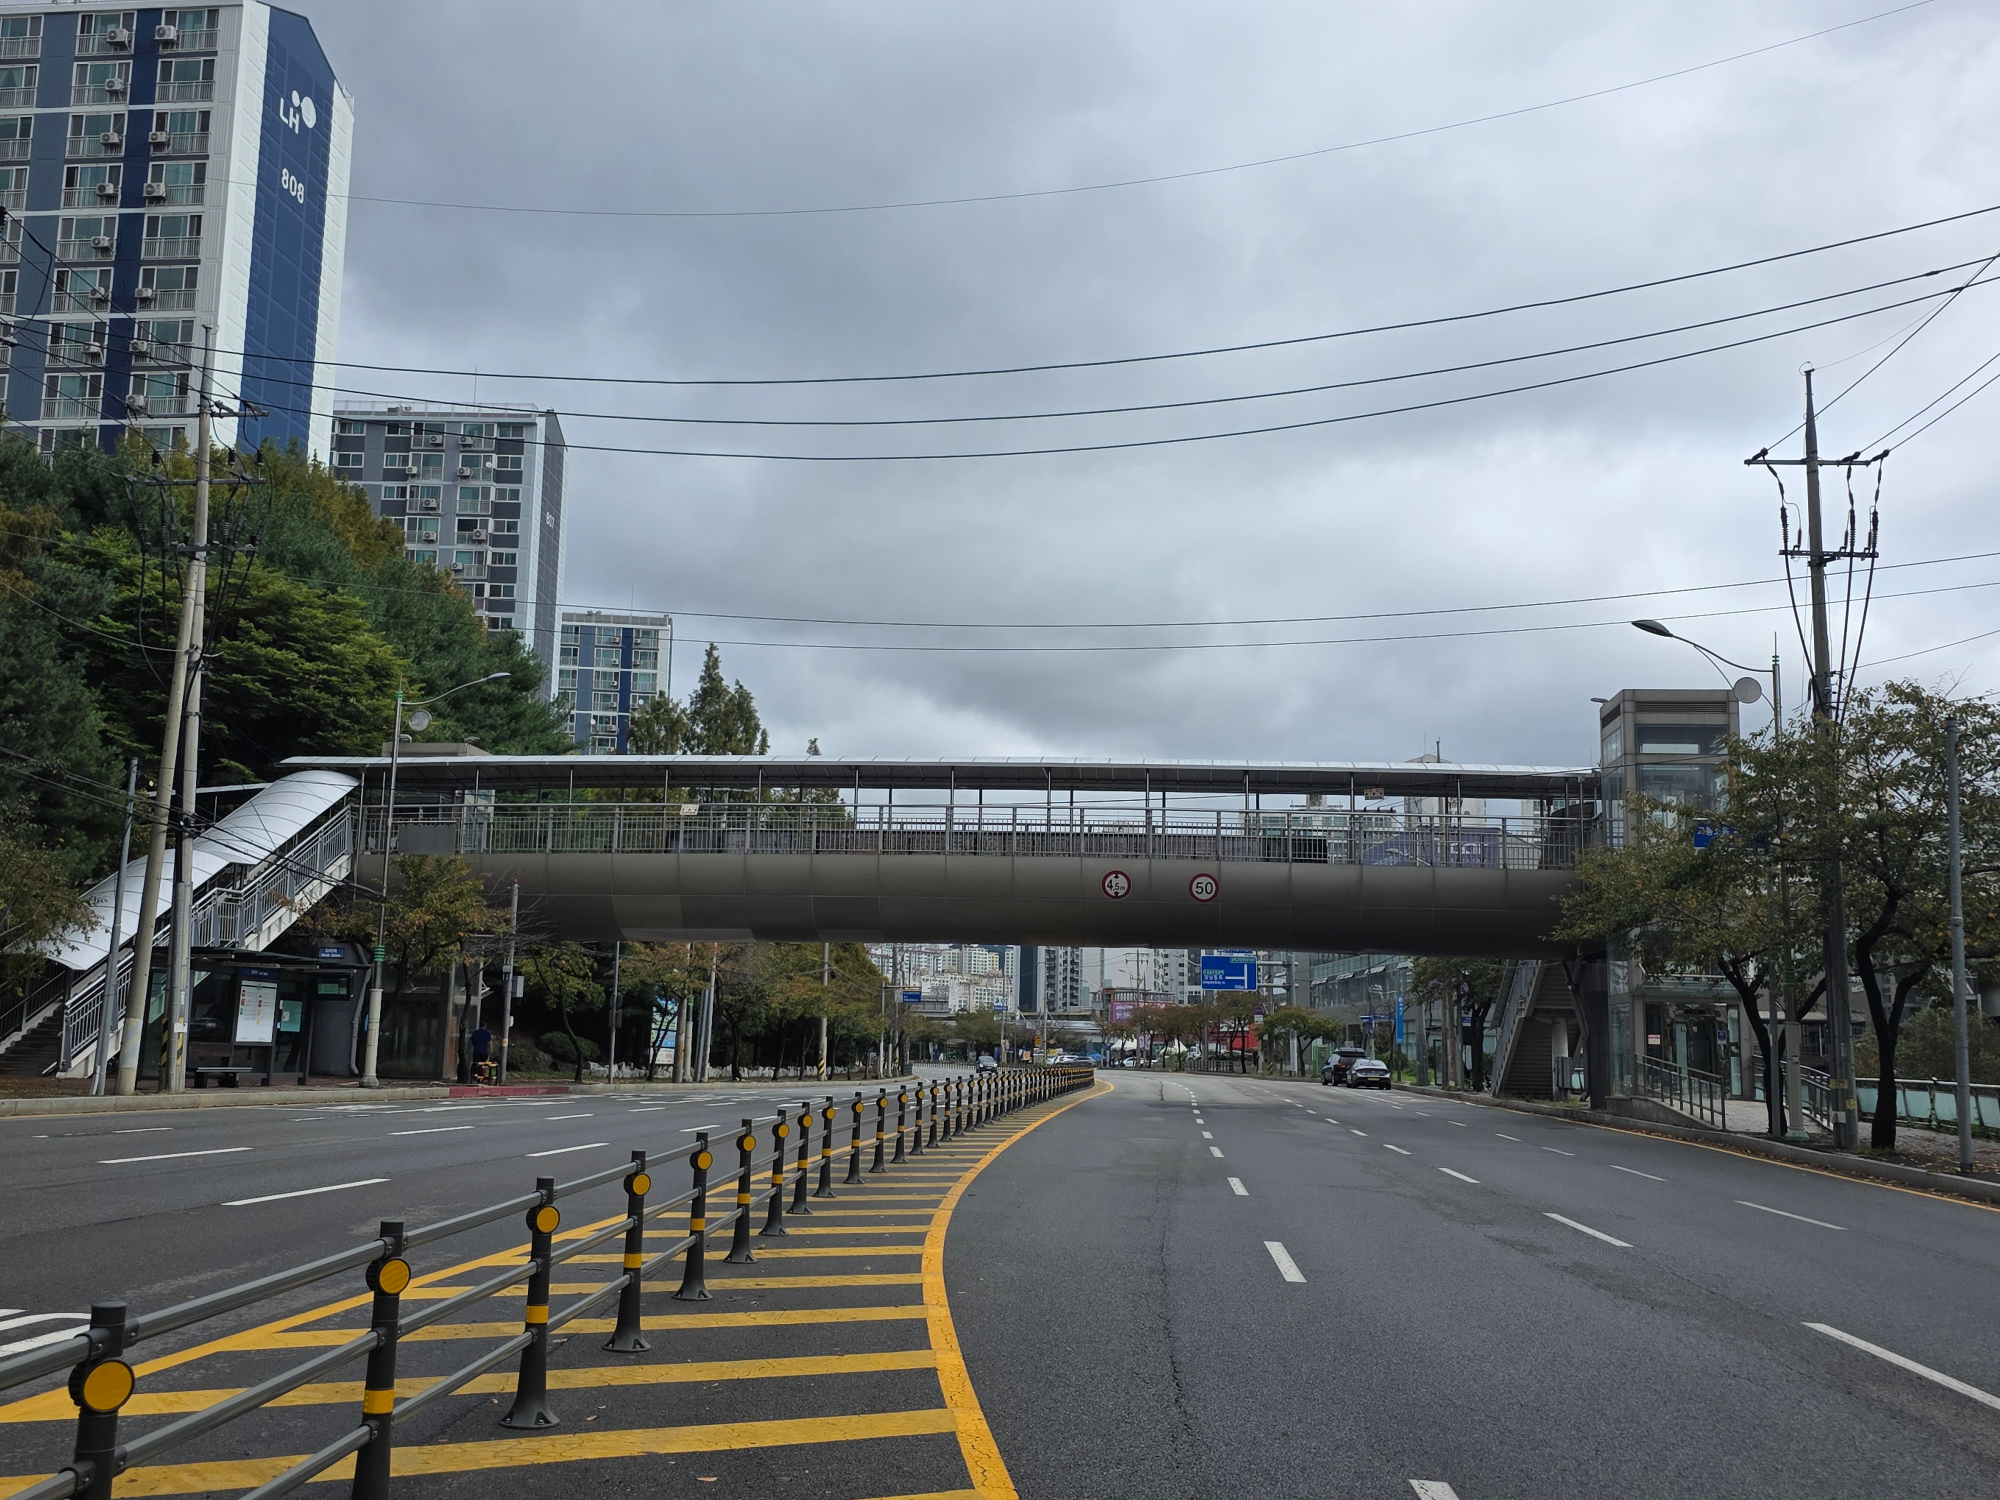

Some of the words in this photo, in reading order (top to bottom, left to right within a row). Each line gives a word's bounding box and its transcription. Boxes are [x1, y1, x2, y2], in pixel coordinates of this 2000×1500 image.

[279, 97, 299, 134] LH
[281, 167, 305, 204] 808
[1106, 878, 1126, 891] 4.5m
[1195, 881, 1213, 895] 50
